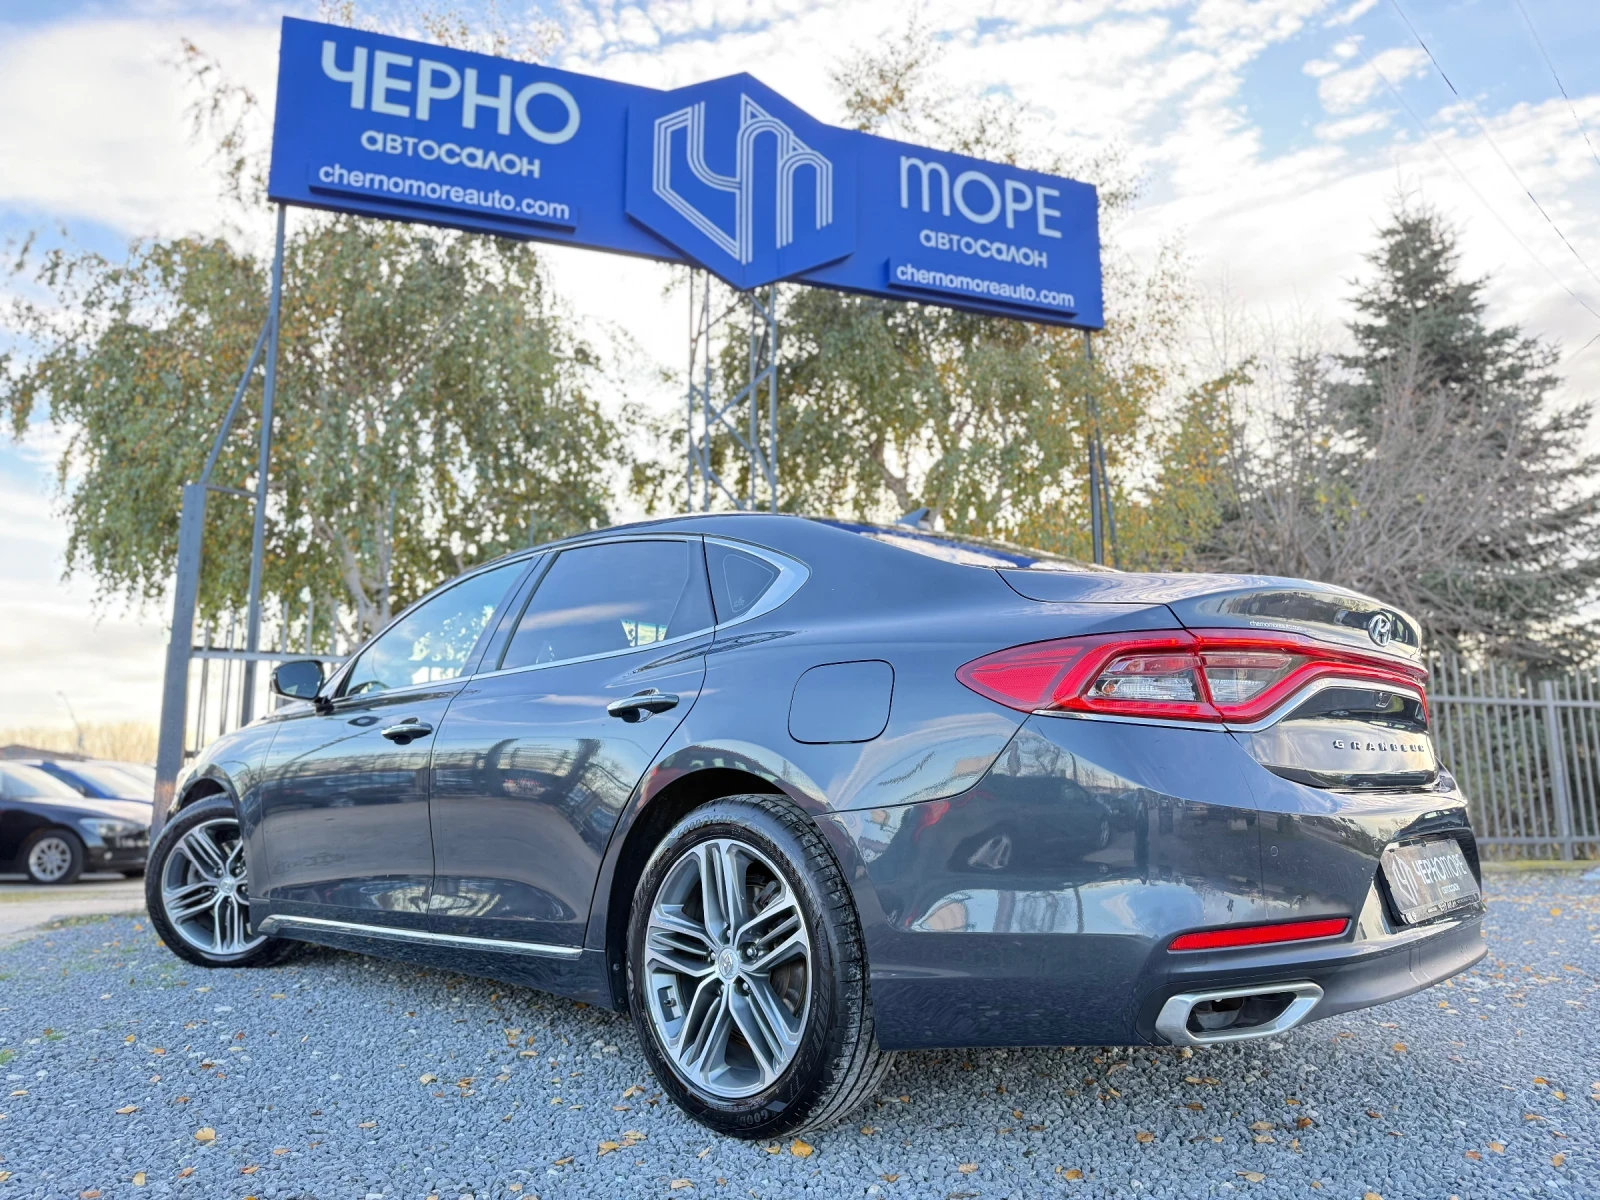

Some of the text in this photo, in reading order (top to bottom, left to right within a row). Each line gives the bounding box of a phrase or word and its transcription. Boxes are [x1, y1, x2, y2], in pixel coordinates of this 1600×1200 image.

[321, 40, 581, 145] ЧЕРНО
[360, 130, 541, 179] автосалон
[319, 163, 570, 220] chernomoreauto.com
[900, 155, 1062, 239] МОРЕ
[919, 229, 1048, 269] автосалон
[896, 263, 1075, 308] chernomoreauto.com
[1333, 739, 1425, 753] GRANDEUR
